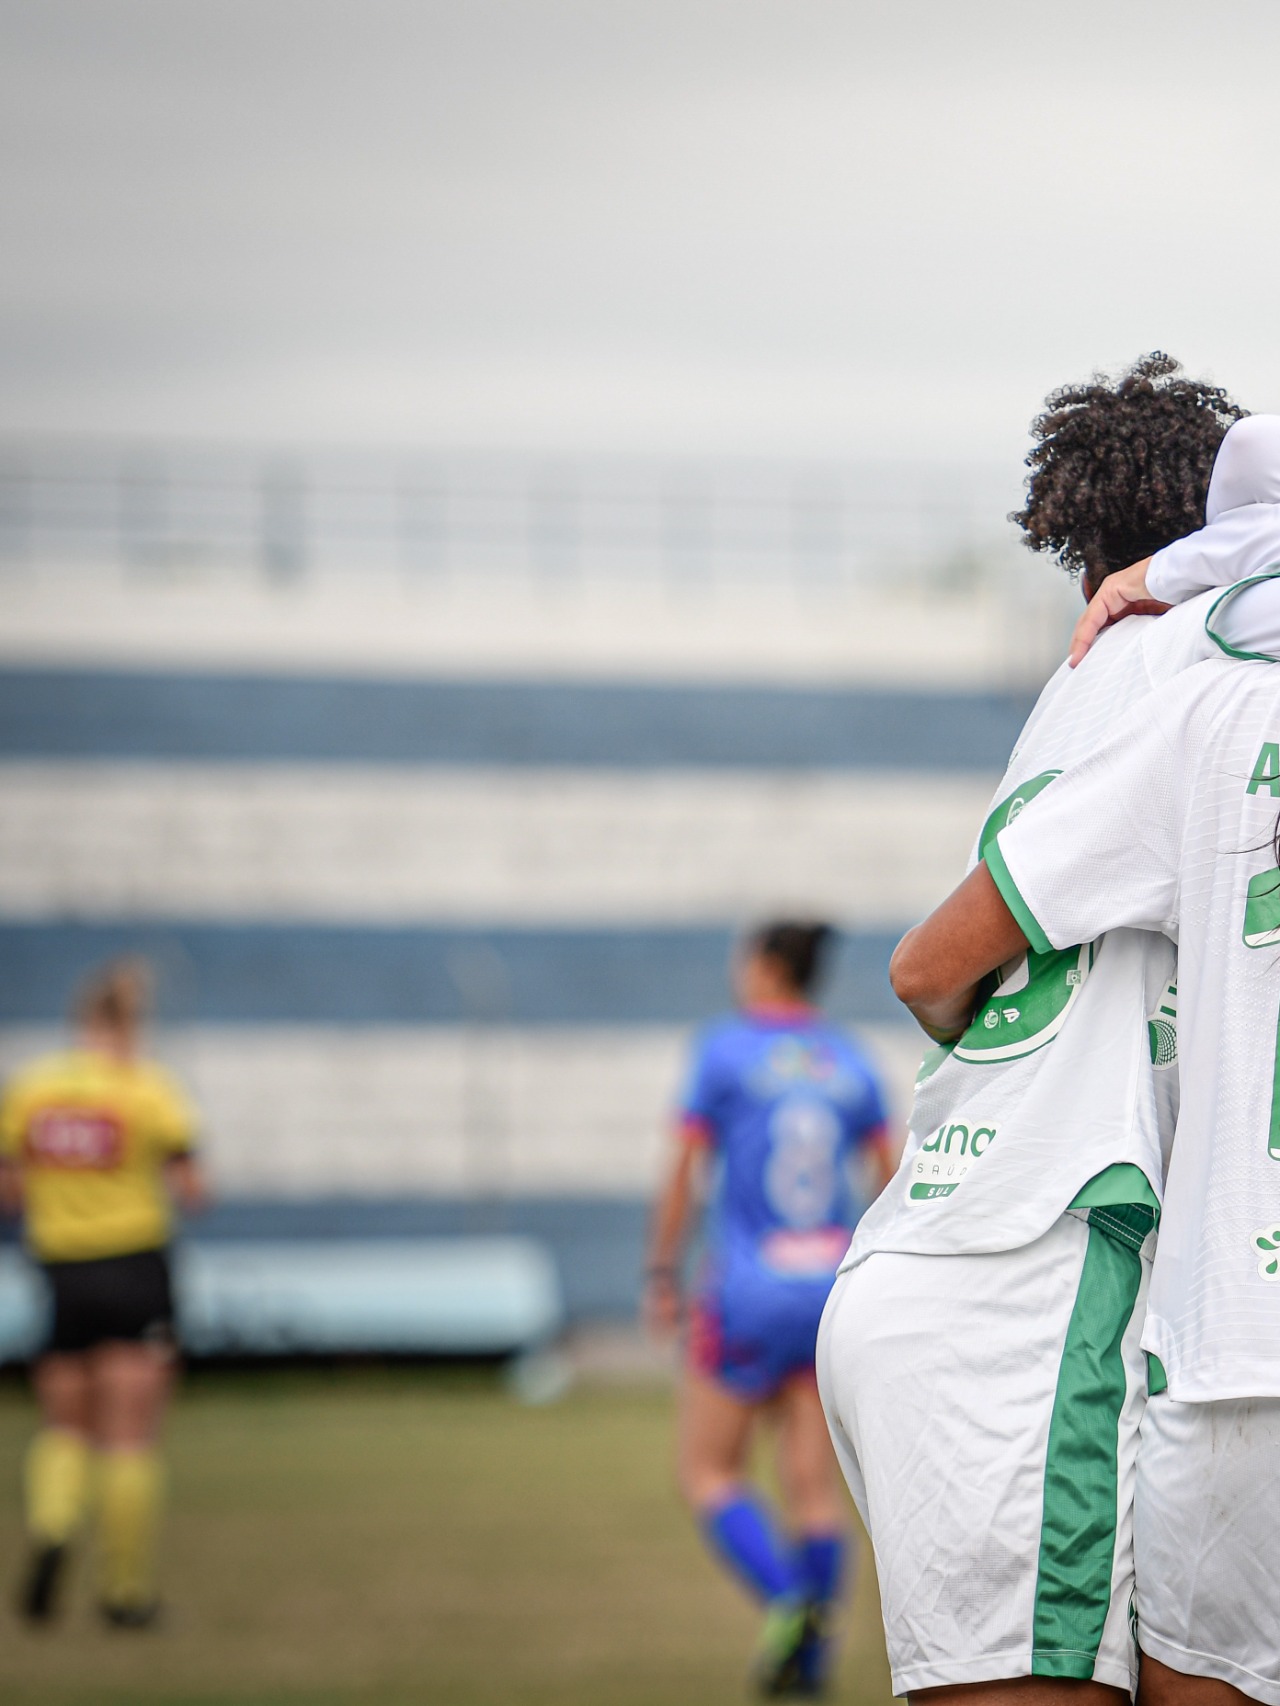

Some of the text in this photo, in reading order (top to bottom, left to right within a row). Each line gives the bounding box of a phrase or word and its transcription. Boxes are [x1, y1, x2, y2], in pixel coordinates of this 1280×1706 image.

[922, 1124, 997, 1157] ana
[916, 1162, 968, 1177] SAÚD
[927, 1186, 950, 1197] SUL
